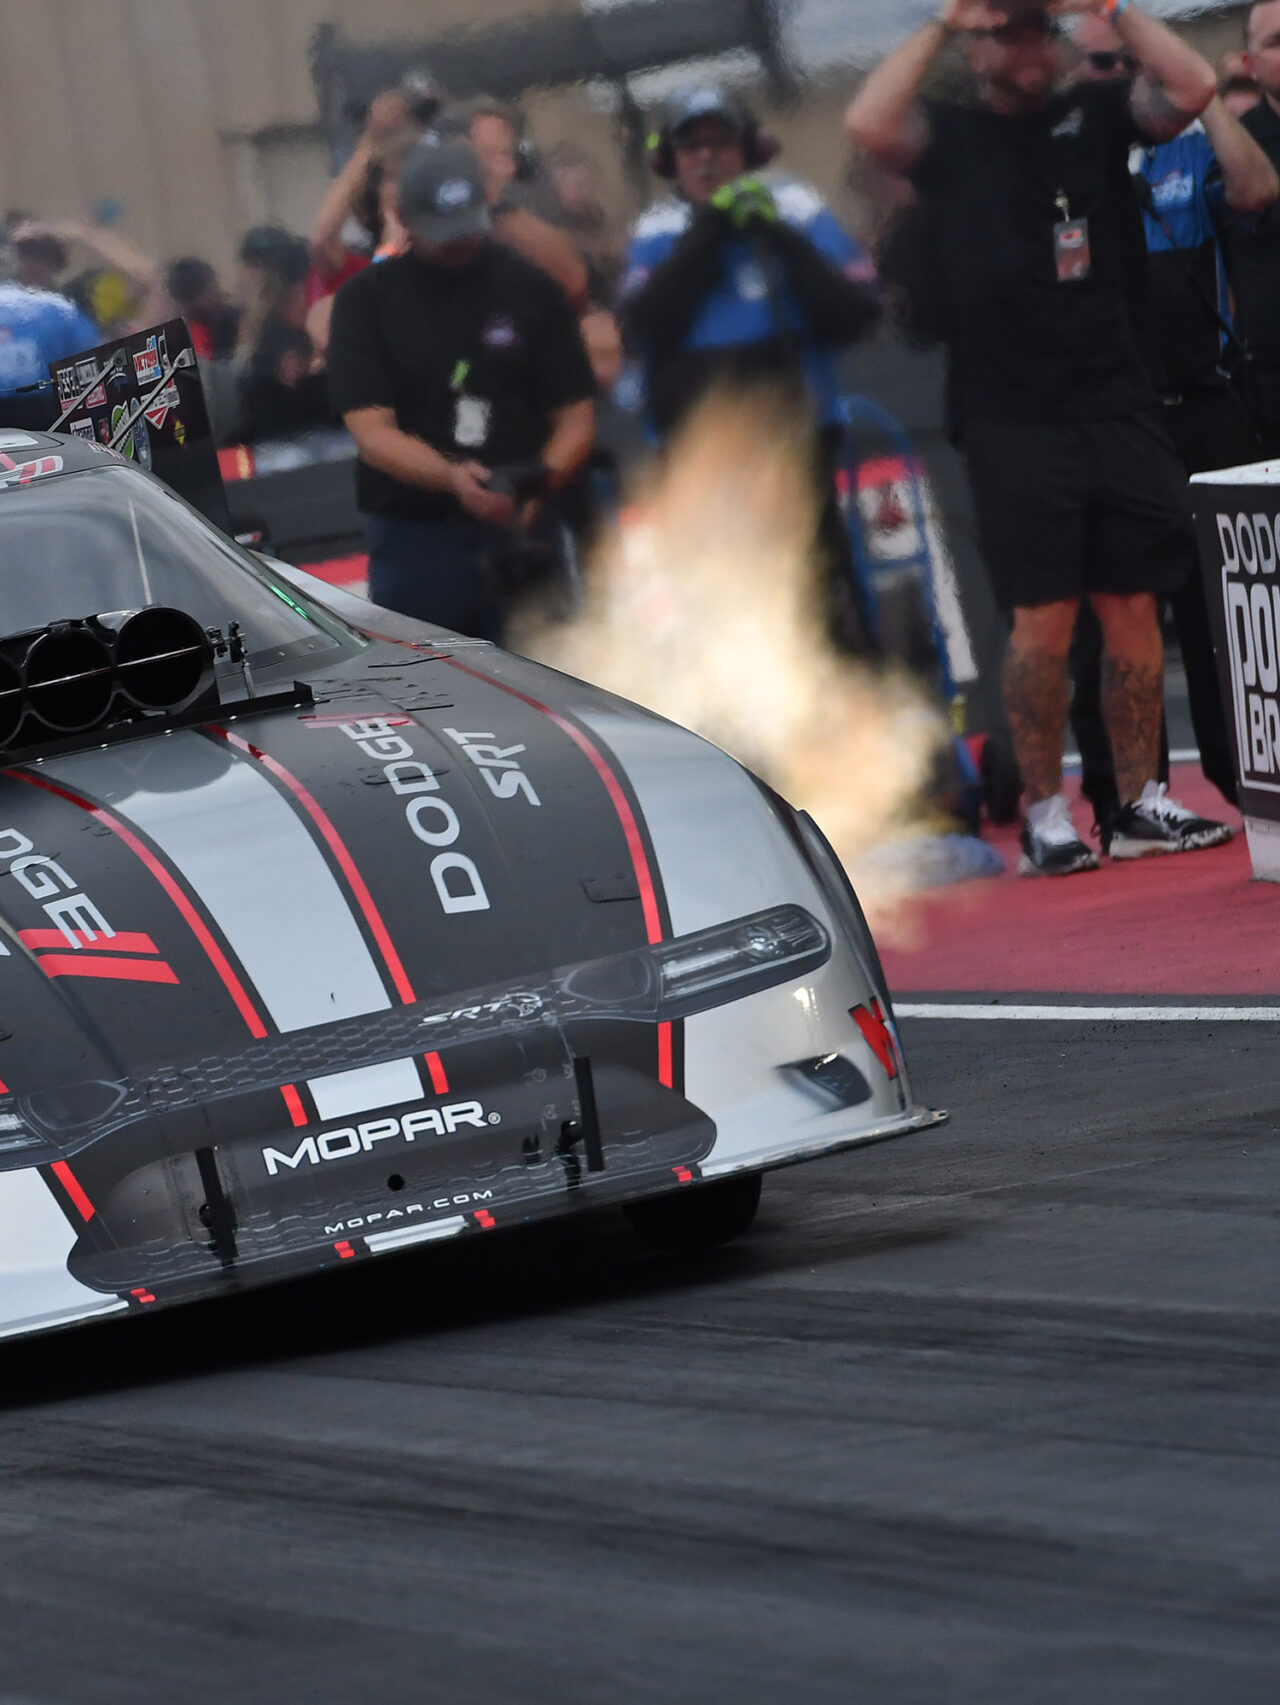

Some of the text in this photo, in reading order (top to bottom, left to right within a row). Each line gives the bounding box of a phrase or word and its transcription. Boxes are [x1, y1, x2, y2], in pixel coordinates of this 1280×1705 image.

[442, 727, 542, 807] SRT
[339, 717, 491, 914] DODGE
[422, 998, 512, 1023] SRT
[324, 1189, 493, 1234] MOPAR.COM
